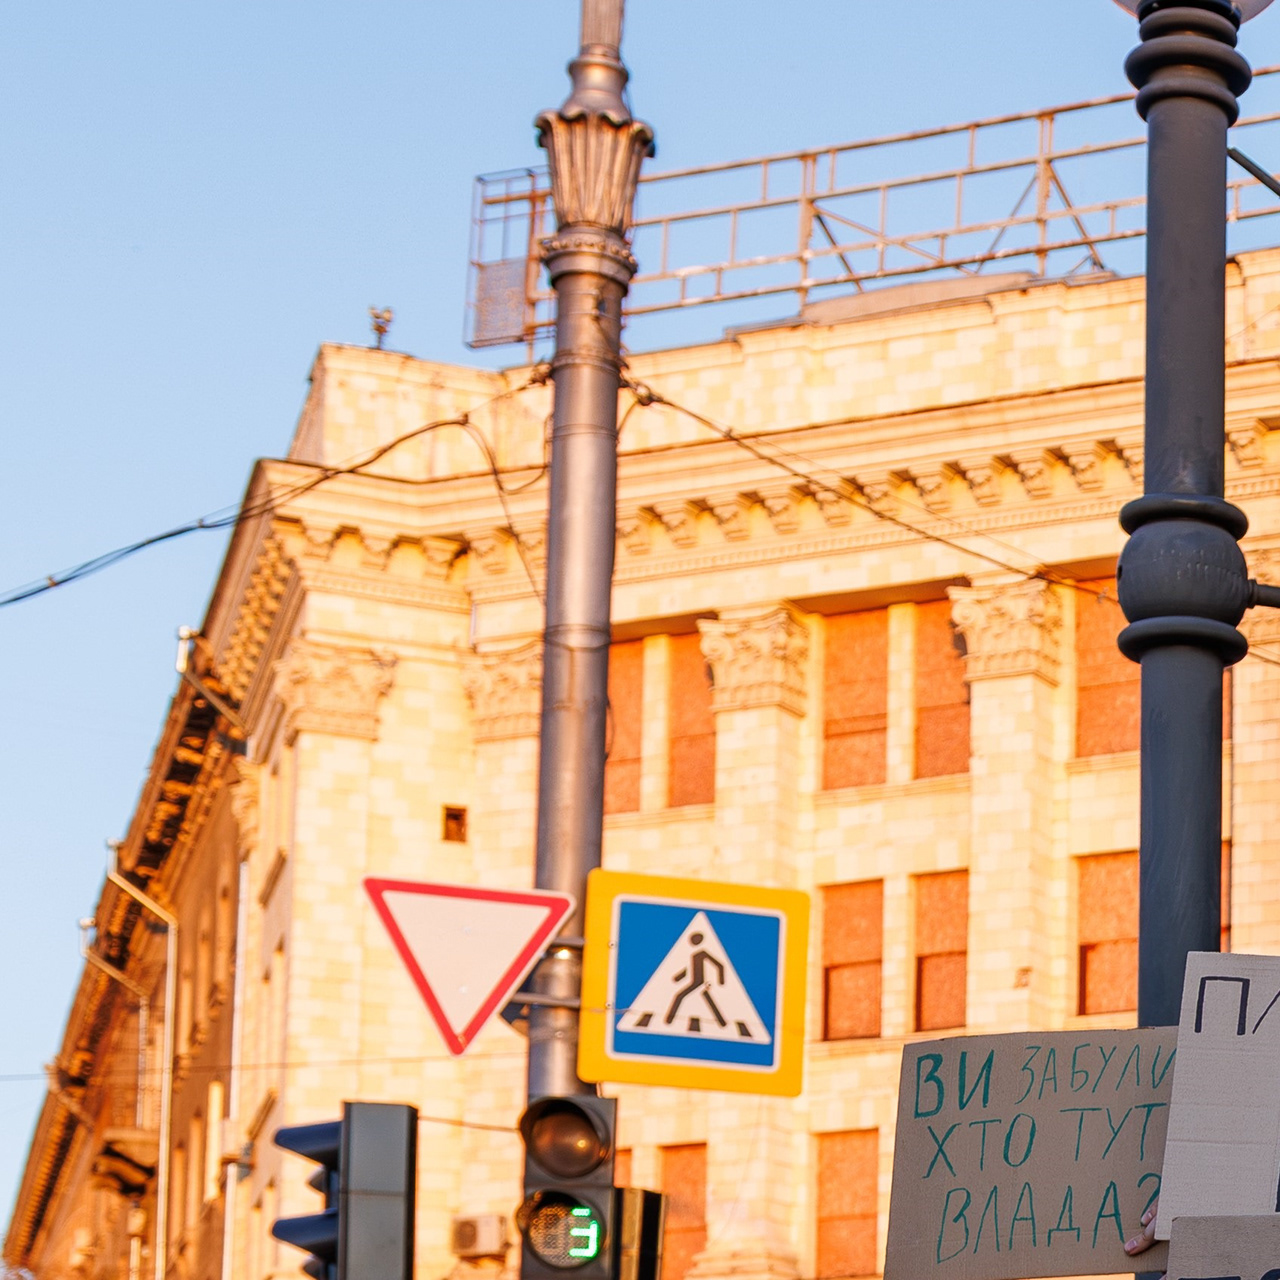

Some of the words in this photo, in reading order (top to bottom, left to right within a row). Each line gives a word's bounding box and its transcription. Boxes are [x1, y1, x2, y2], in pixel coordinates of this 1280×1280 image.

[914, 1050, 994, 1119] ВИ
[922, 1113, 1036, 1178] ХТО
[1059, 1103, 1167, 1161] ТУТ
